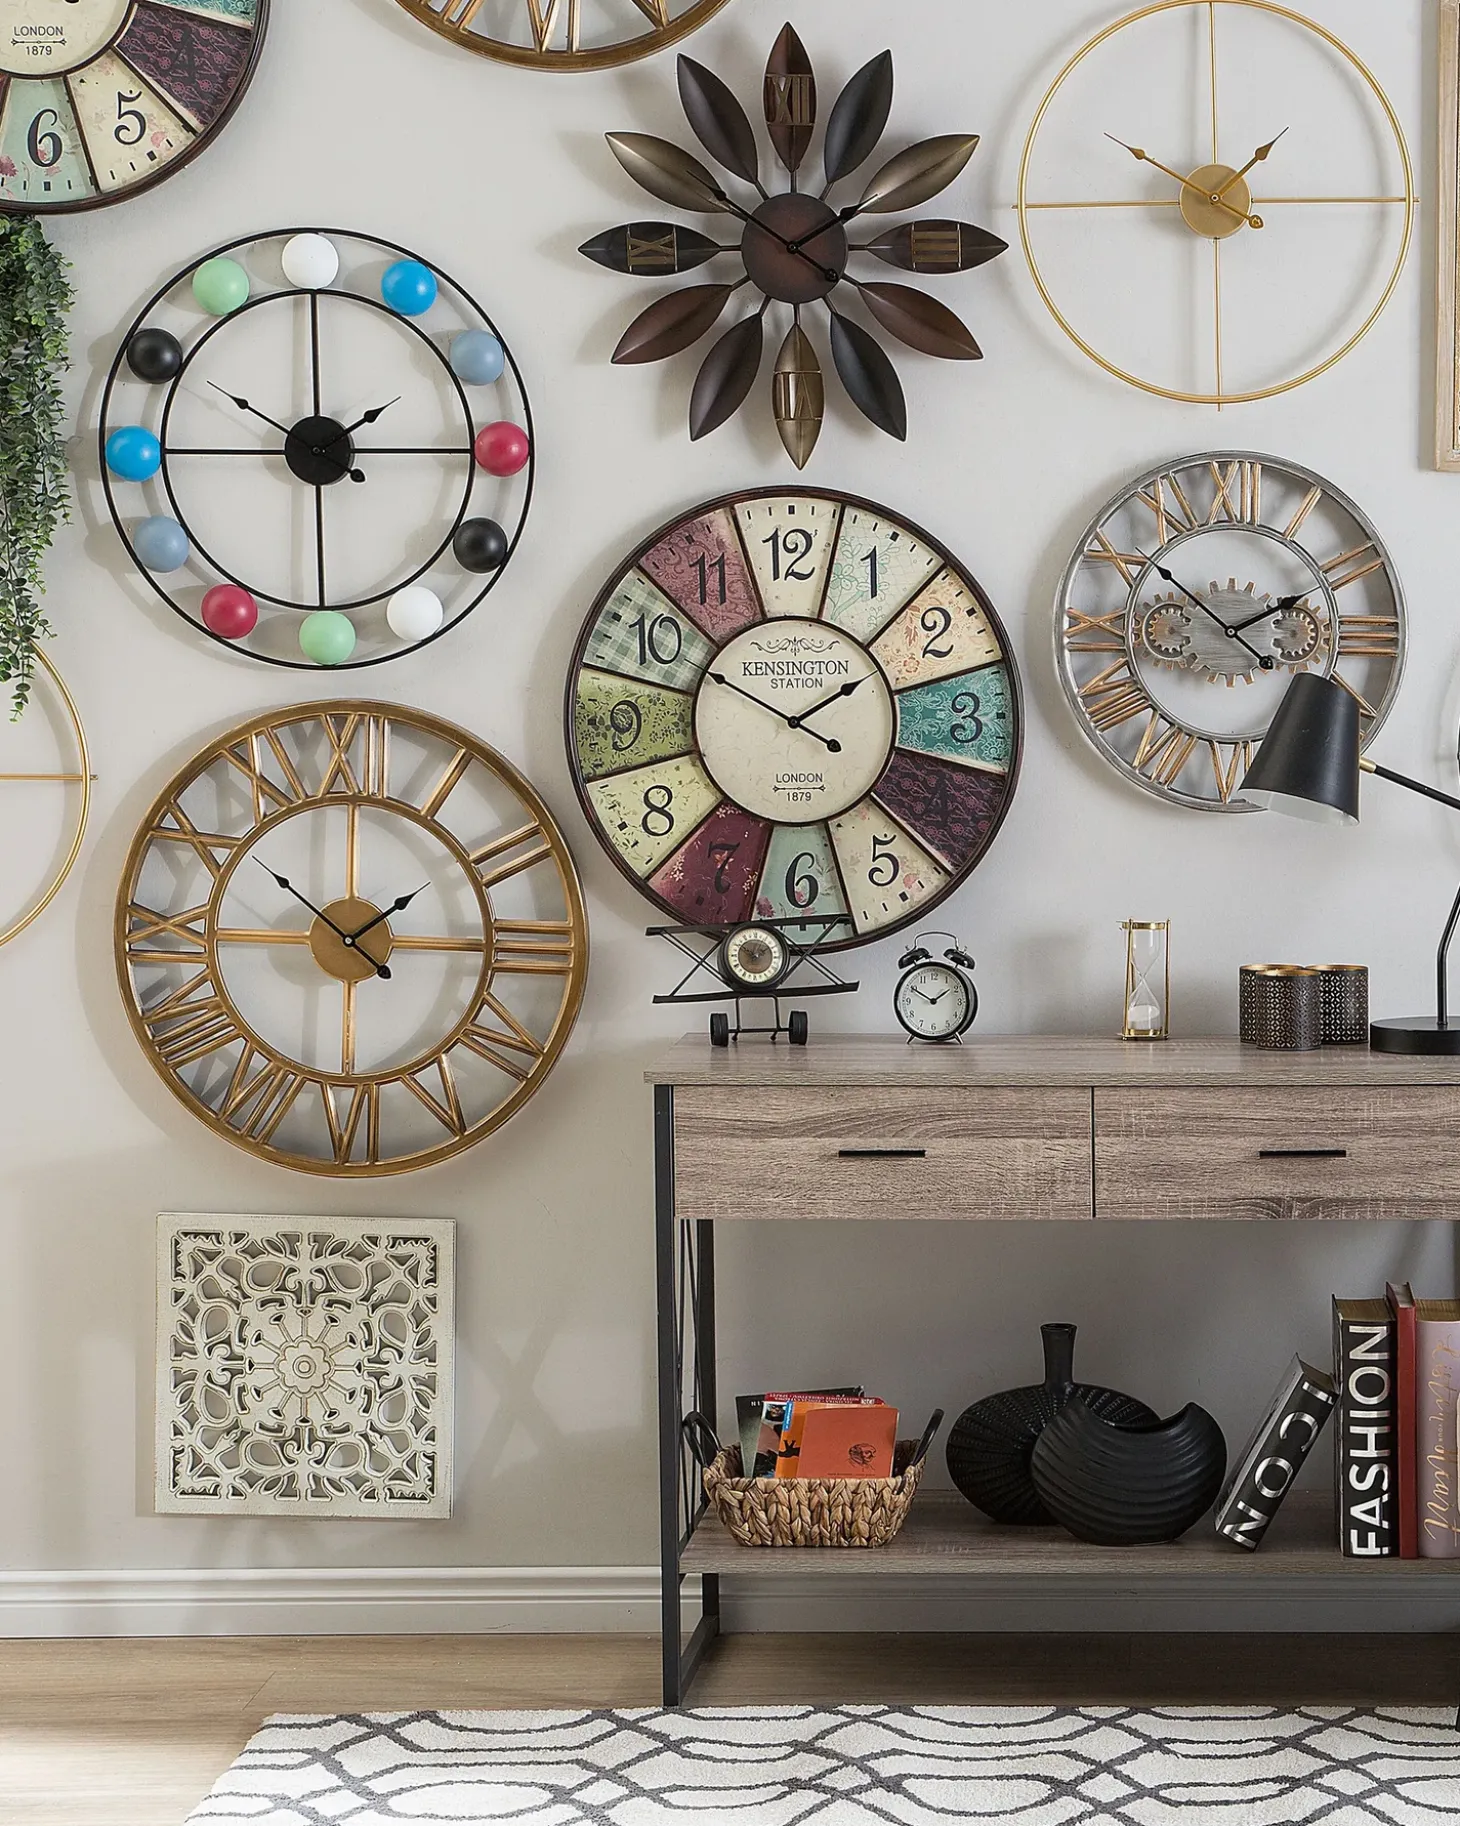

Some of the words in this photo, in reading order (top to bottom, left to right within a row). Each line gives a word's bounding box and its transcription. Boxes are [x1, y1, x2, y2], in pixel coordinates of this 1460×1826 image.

[13, 26, 64, 37] LONDON
[25, 46, 52, 56] 1879
[27, 109, 63, 167] 6
[114, 90, 146, 146] 5
[1209, 460, 1262, 525] XII
[688, 551, 727, 607] 11
[763, 527, 816, 582] 12
[860, 545, 878, 599] 1
[628, 612, 682, 666] 10
[920, 606, 954, 660] 2
[742, 660, 849, 677] KENSINGTON
[770, 678, 823, 689] STATION
[610, 699, 642, 752] 9
[950, 692, 982, 744] 3
[319, 713, 389, 798] XII
[775, 772, 823, 783] LONDON
[641, 785, 675, 836] 8
[785, 791, 812, 802] 1879
[707, 840, 740, 894] 7
[784, 851, 819, 909] 6
[867, 832, 897, 887] 5
[920, 976, 926, 984] 11
[957, 998, 962, 1006] 3
[910, 1010, 915, 1018] 8
[1222, 1382, 1334, 1549] ICON
[1349, 1325, 1390, 1555] FASHION
